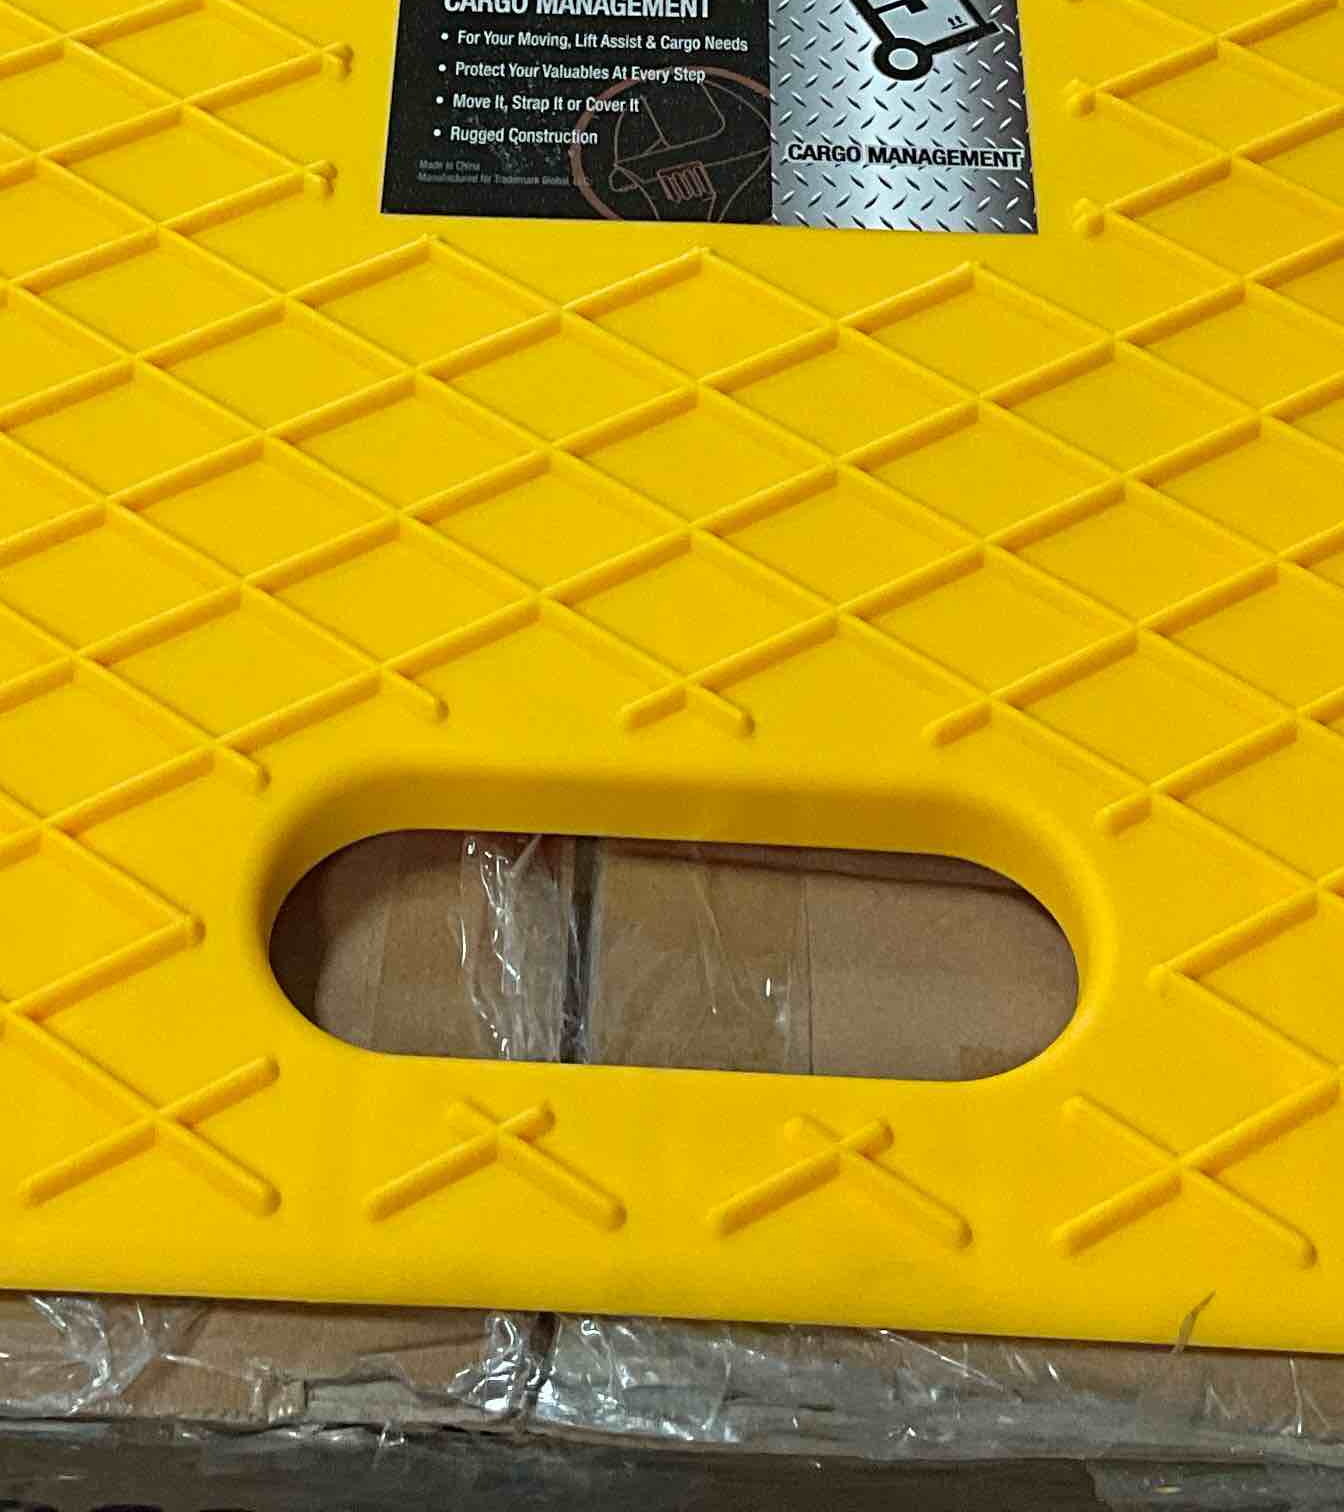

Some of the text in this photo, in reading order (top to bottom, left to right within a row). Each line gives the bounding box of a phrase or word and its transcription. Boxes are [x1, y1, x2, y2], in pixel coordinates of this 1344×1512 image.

[457, 30, 748, 53] For Your Moving, Lift Assist & Cargo Needs
[455, 61, 706, 84] Protect Your Valuables At Every Step
[452, 94, 640, 114] Move It, Strap It or Cover It
[450, 126, 598, 145] Rugged Construction
[419, 160, 443, 170] Made
[788, 143, 1021, 168] CARGO MANAGEMENT
